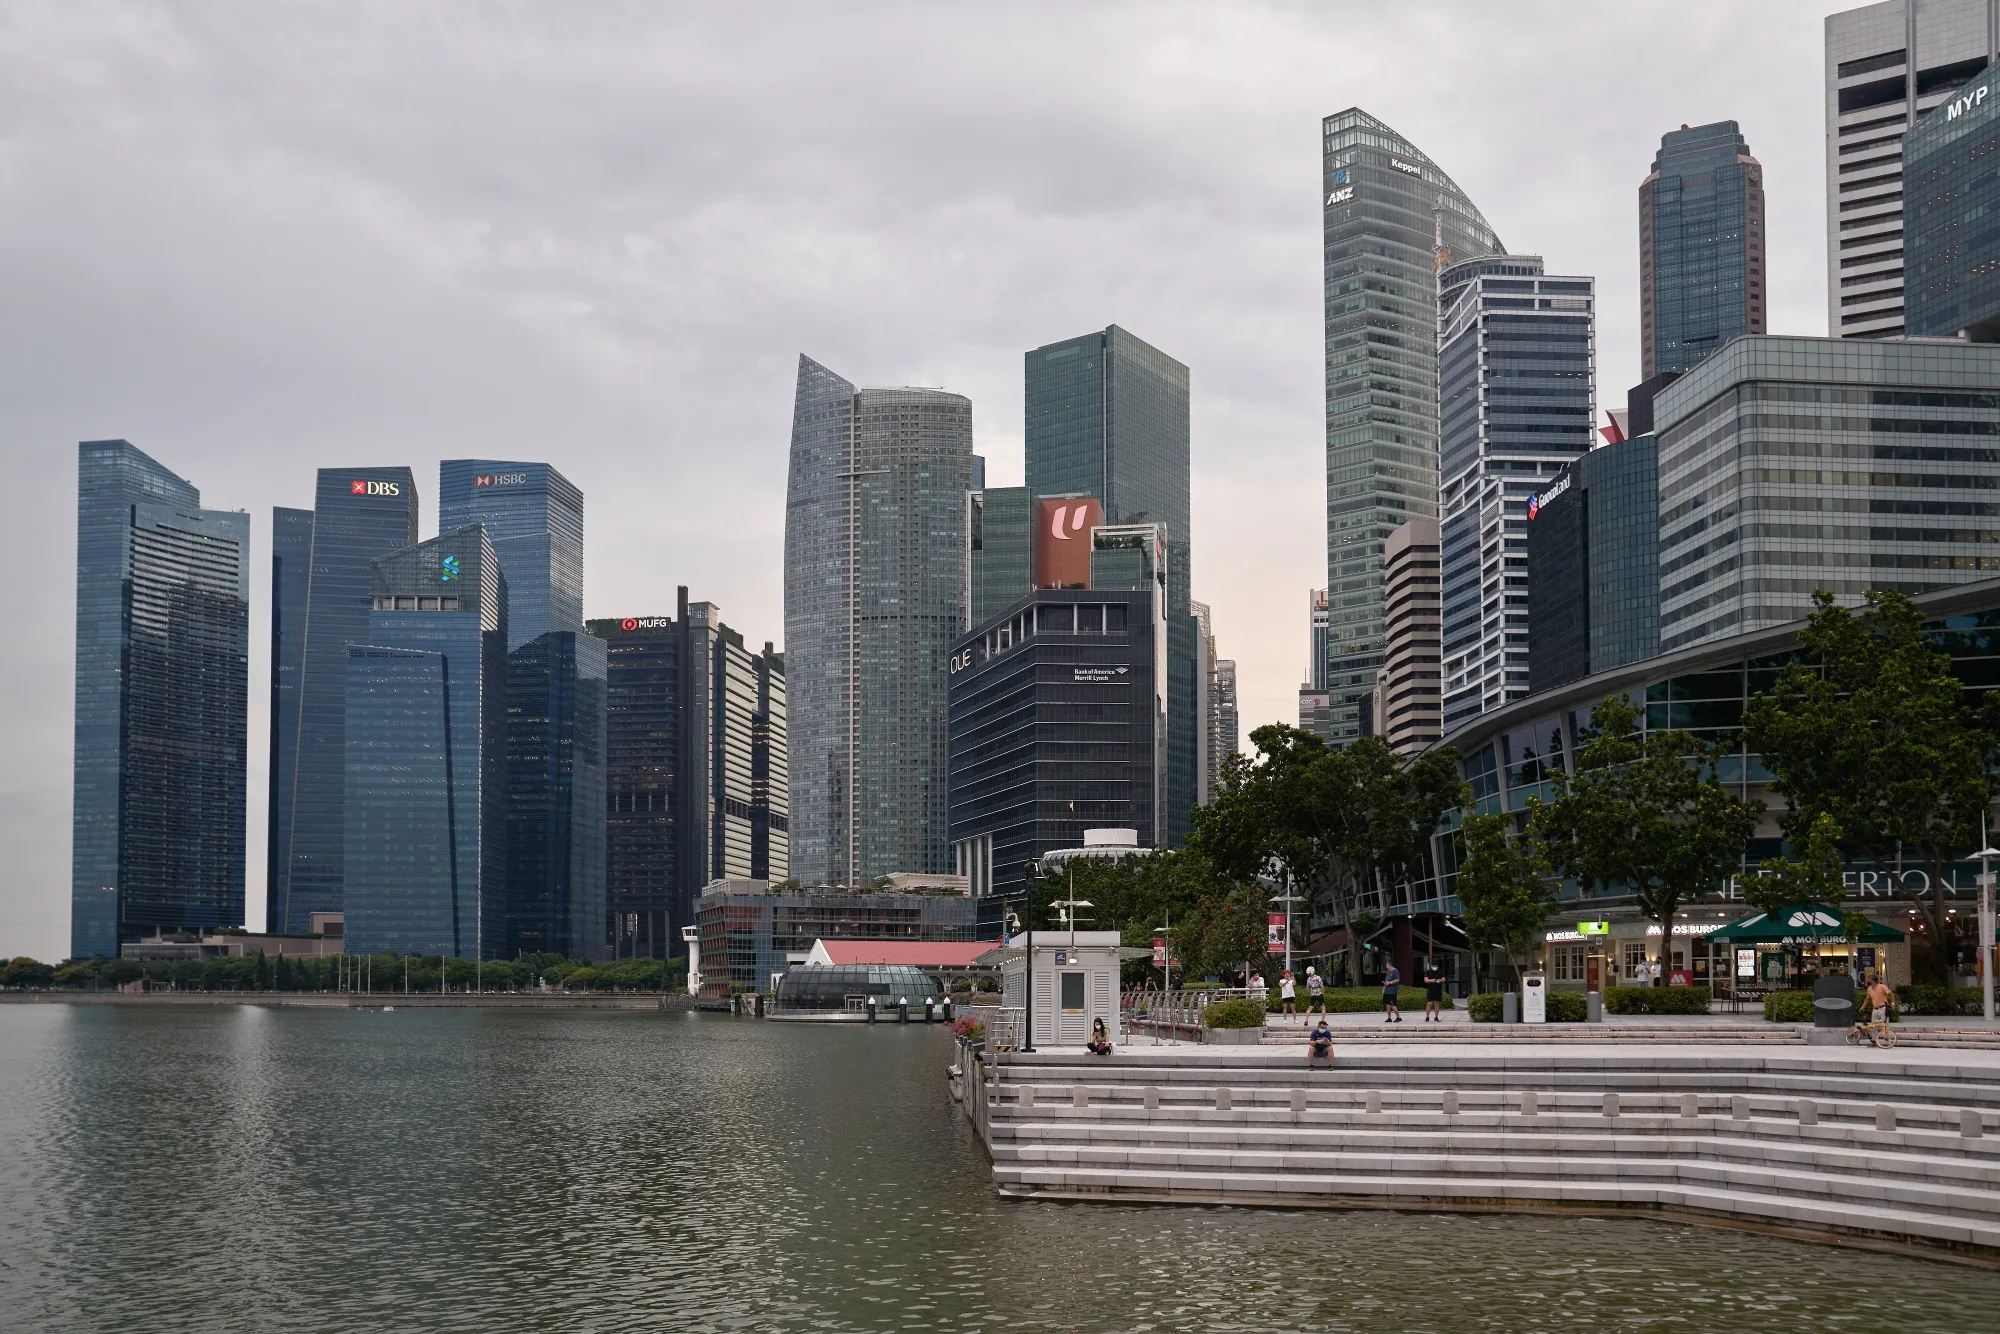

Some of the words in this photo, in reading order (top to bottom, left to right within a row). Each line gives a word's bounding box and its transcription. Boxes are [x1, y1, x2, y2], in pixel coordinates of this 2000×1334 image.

[1947, 85, 1988, 122] MYP
[1391, 158, 1421, 175] Keppel
[1326, 186, 1354, 206] ANZ
[494, 473, 527, 485] HSBC
[367, 481, 400, 496] DBS
[638, 618, 667, 628] MUFG
[950, 648, 971, 675] OUE
